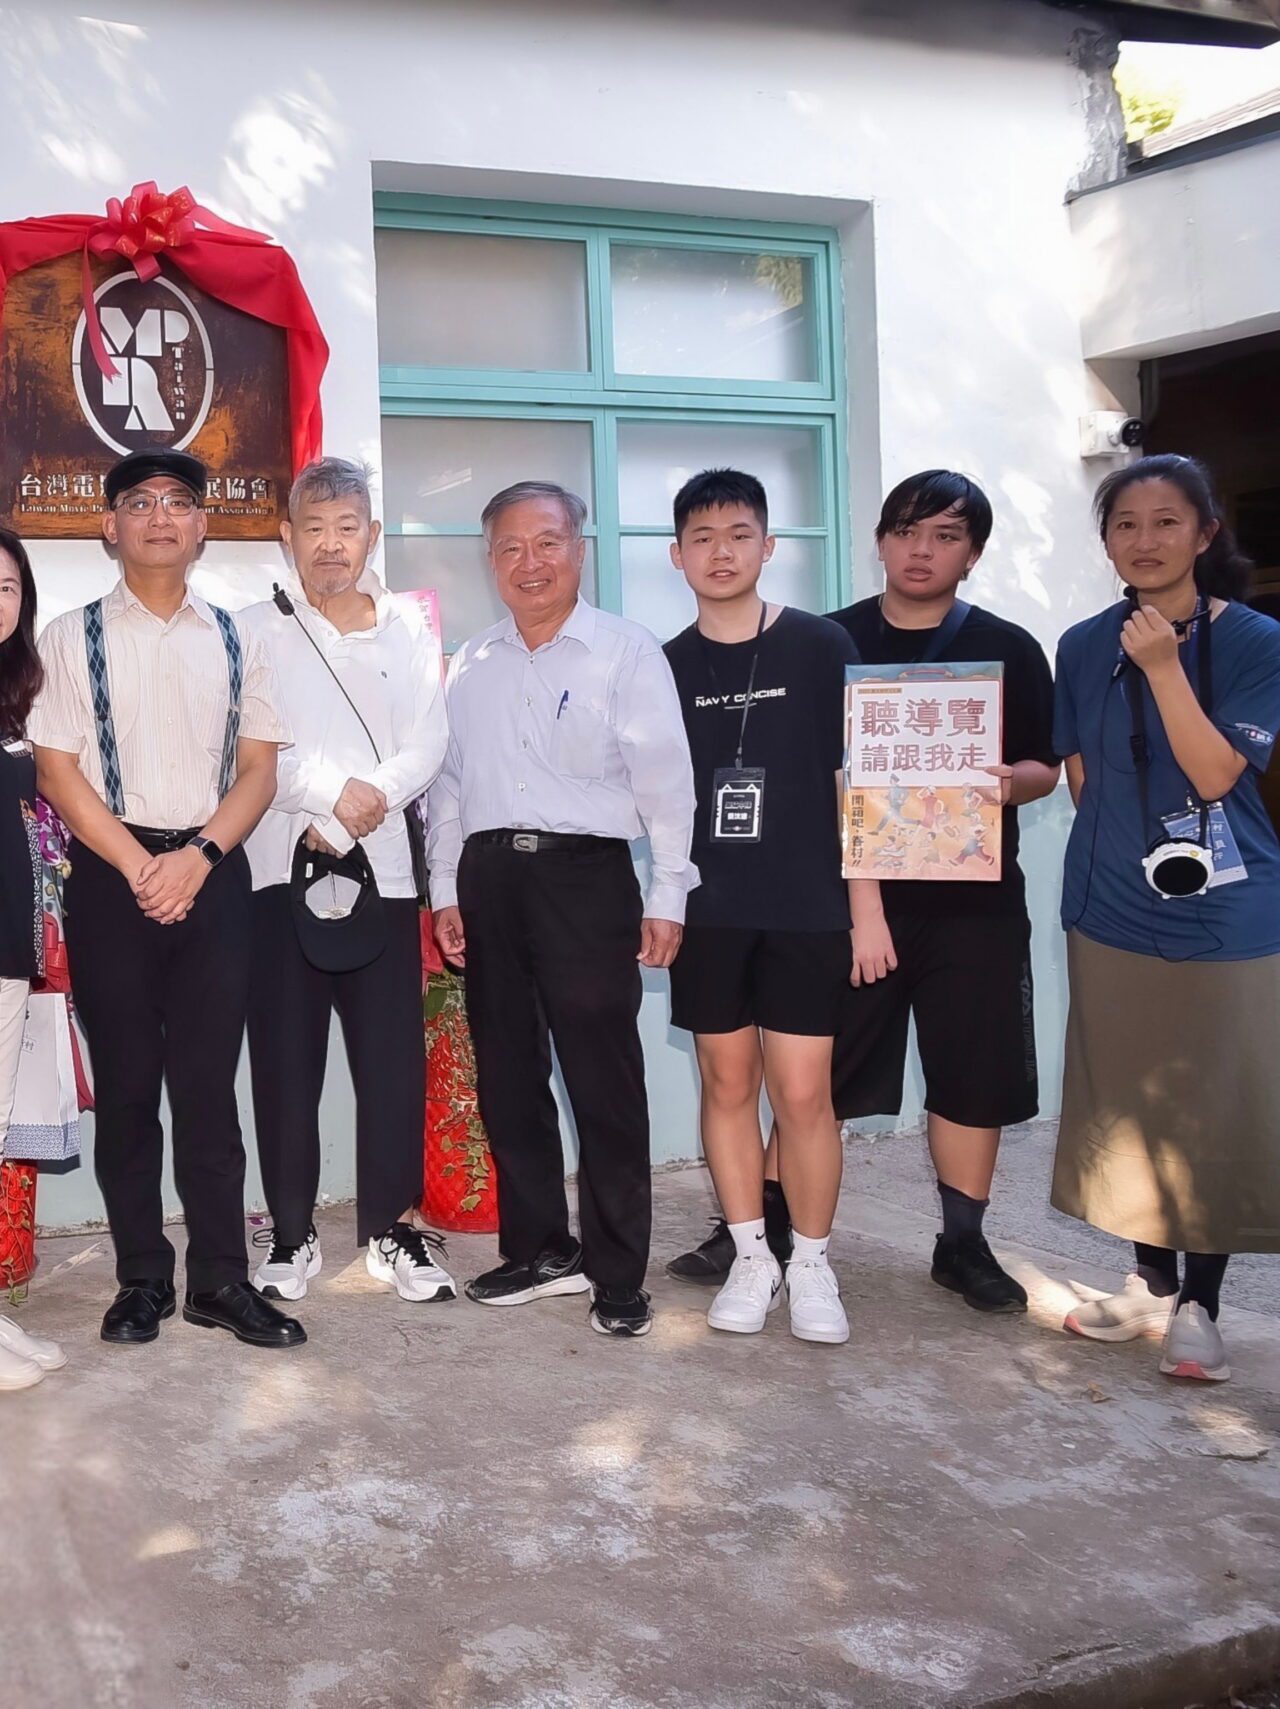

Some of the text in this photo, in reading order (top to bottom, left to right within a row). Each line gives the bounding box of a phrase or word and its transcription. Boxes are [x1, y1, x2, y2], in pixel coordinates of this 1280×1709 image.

[172, 346, 186, 420] Taiwan
[860, 697, 987, 738] 聽導覽
[860, 742, 987, 773] 請跟我走
